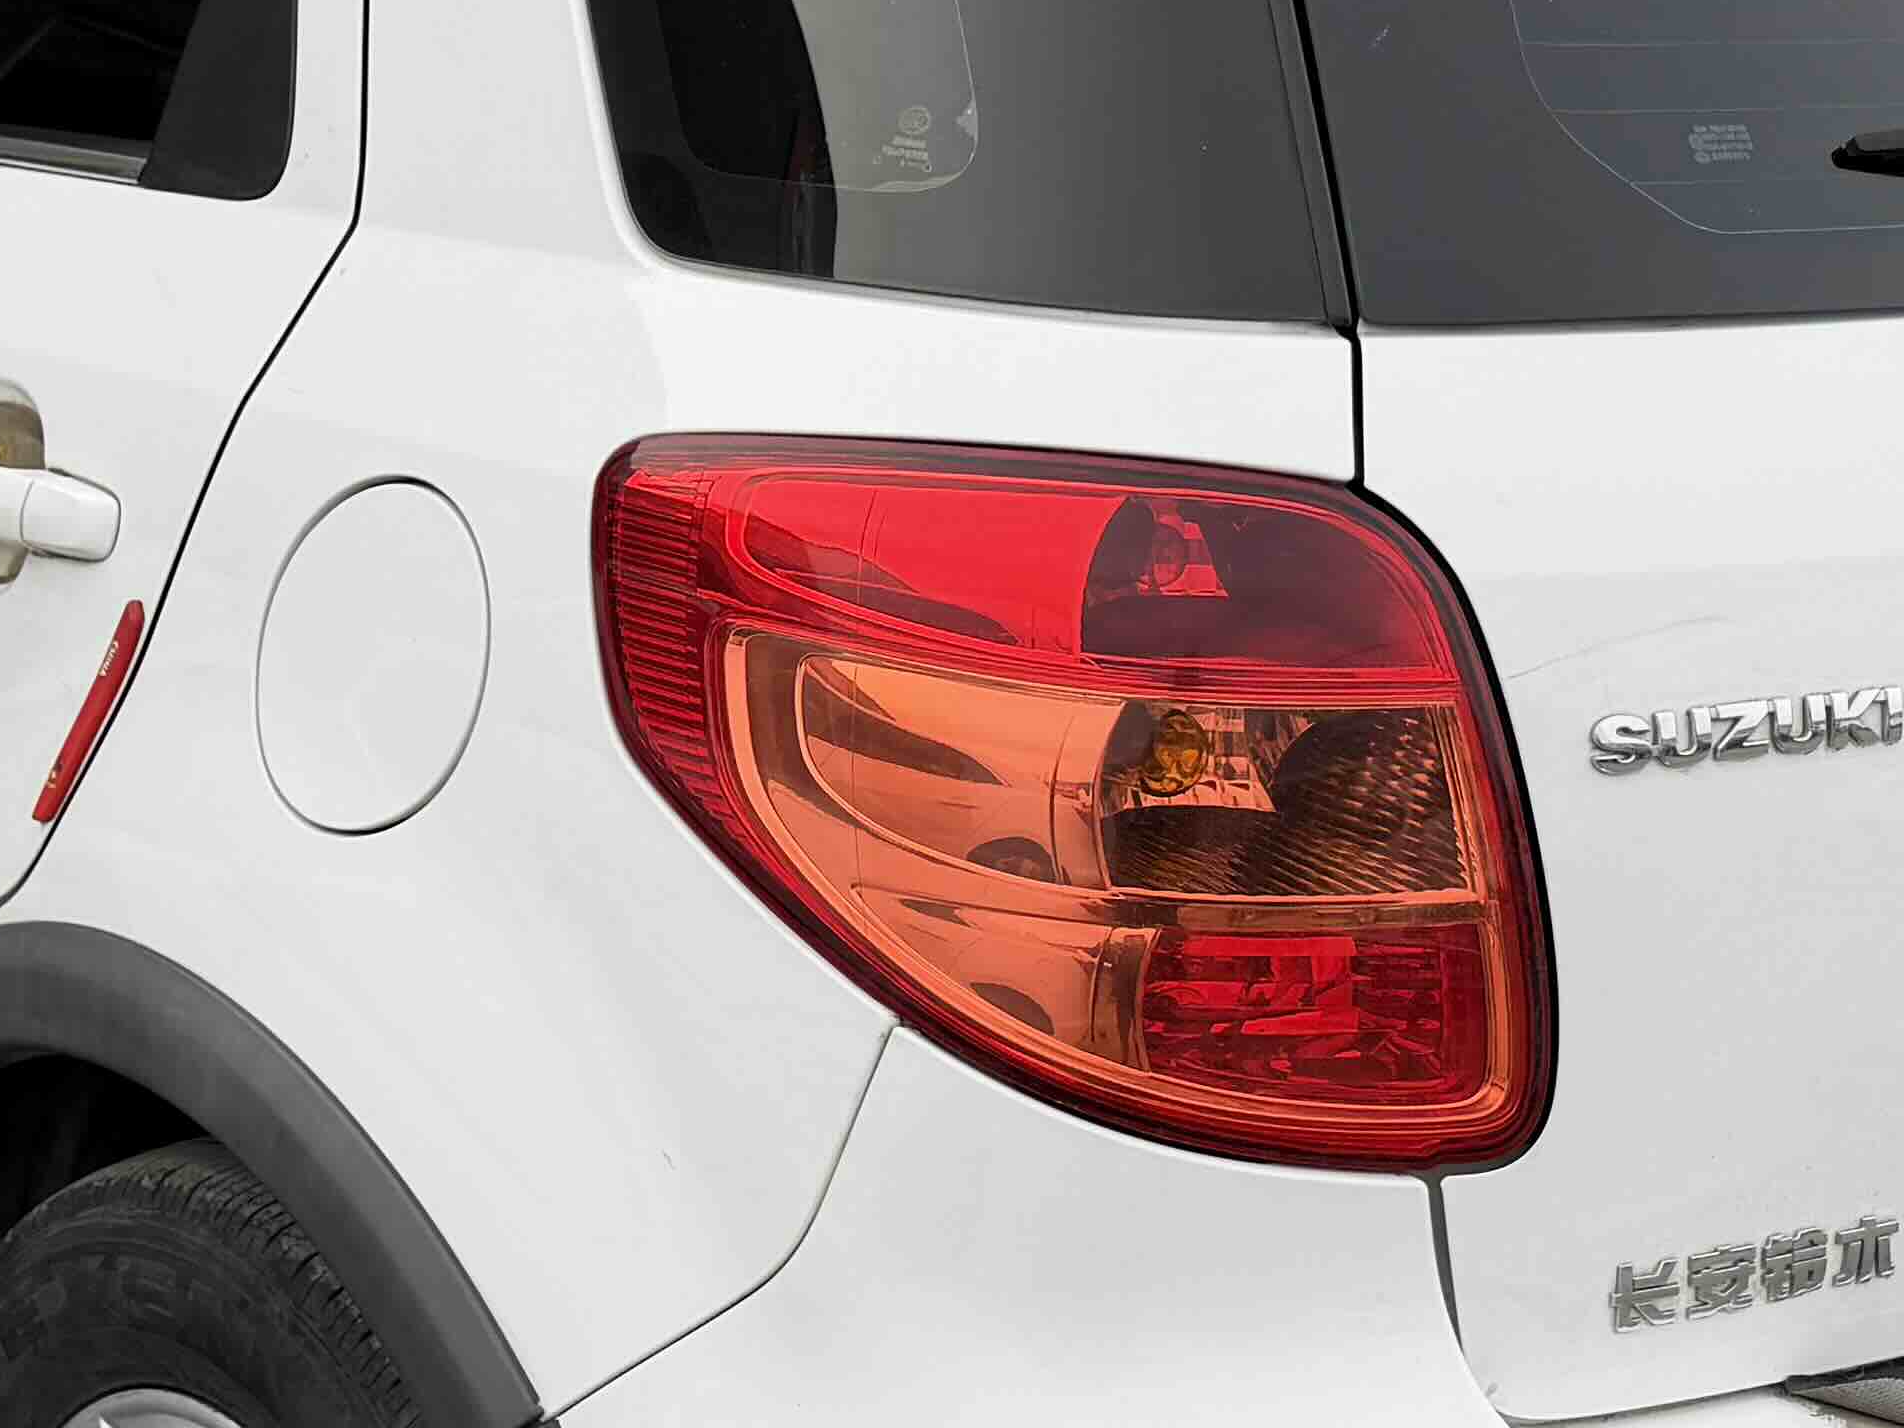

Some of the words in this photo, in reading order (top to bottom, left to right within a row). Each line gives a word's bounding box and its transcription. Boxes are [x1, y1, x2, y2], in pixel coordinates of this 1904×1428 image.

[1590, 684, 1904, 775] SUZUKI
[1608, 1215, 1900, 1333] 长安铃木
